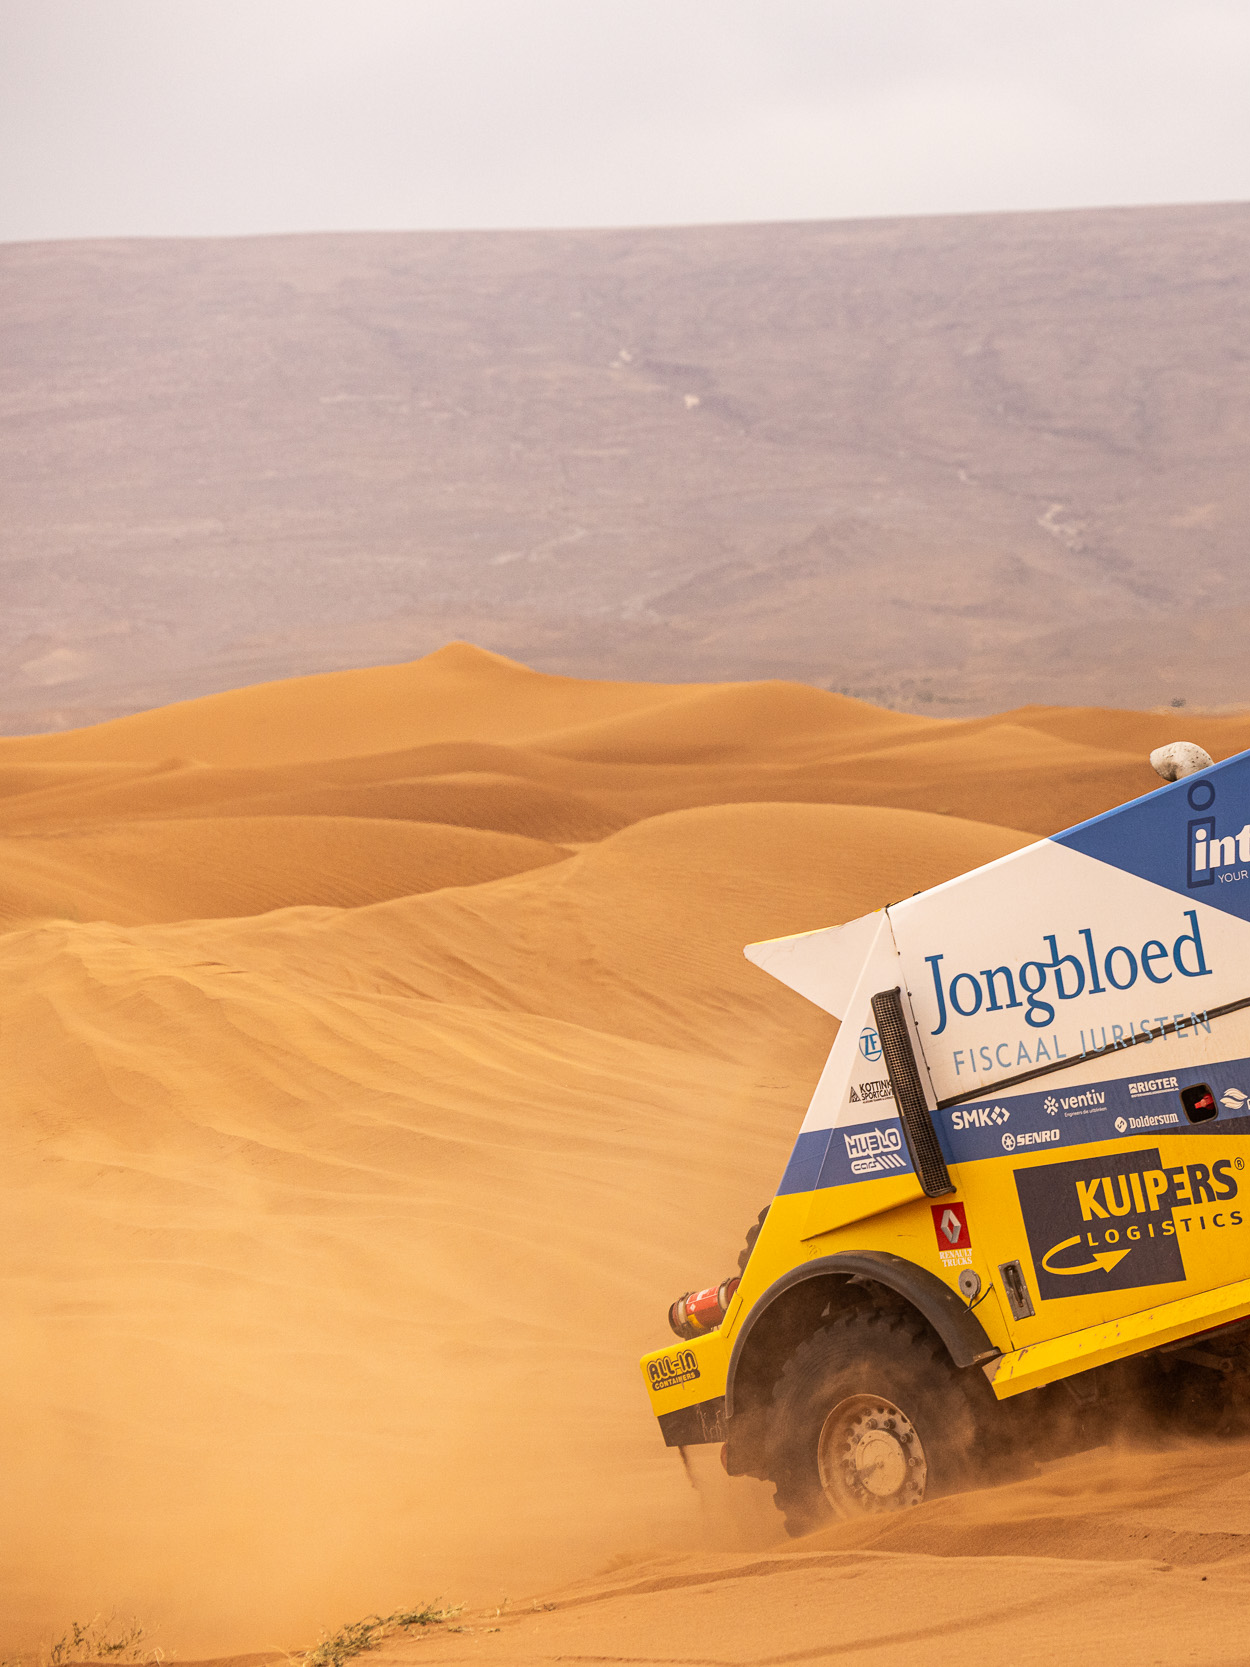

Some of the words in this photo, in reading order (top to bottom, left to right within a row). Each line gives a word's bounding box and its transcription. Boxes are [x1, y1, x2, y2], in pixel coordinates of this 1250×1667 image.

[1218, 870, 1249, 884] YOUR
[924, 910, 1212, 1036] Jongbloed
[860, 1033, 882, 1056] ZF
[954, 1034, 1067, 1076] FISCAAL
[1079, 1010, 1212, 1059] JURISTEN
[1138, 1076, 1178, 1093] RIGTER
[860, 1088, 894, 1101] SPORTCAV
[1060, 1089, 1106, 1110] ventiv
[952, 1107, 994, 1130] SMK
[1128, 1113, 1179, 1129] Doldersum
[1016, 1129, 1060, 1146] SENRO
[1088, 1210, 1243, 1247] LOGISTICS
[939, 1248, 972, 1260] RENAULT
[942, 1256, 972, 1267] TRUCKS
[647, 1350, 698, 1384] ALL-IN
[654, 1371, 697, 1390] CONTAINERS
